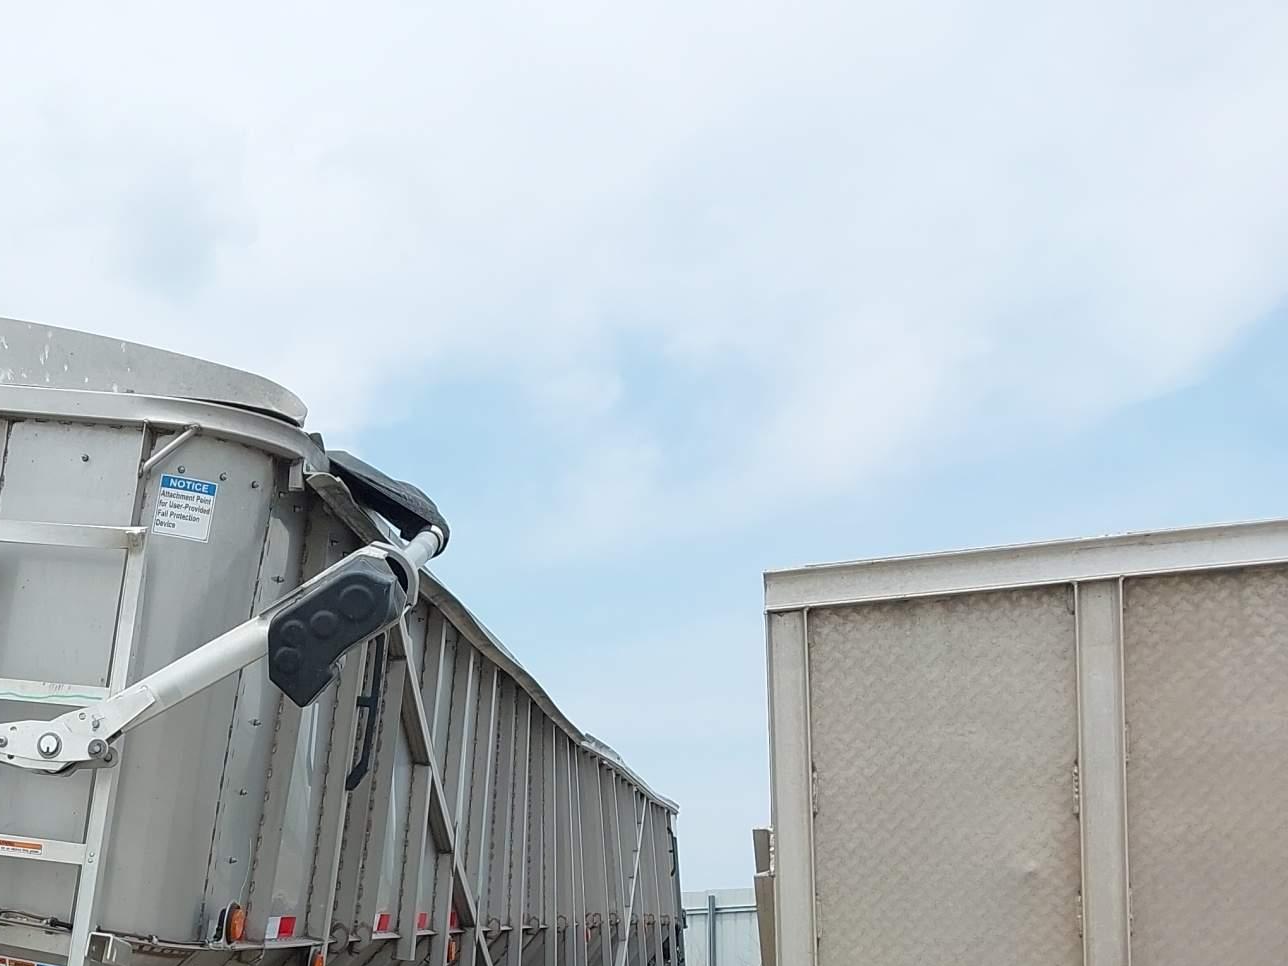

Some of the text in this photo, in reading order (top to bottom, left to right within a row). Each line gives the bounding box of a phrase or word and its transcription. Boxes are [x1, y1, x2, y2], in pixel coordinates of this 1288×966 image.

[170, 479, 209, 493] NOTICE
[161, 490, 212, 505] Attachment Point
[169, 501, 211, 514] User-Provided
[157, 509, 200, 522] Fall Protection
[156, 519, 175, 528] Device
